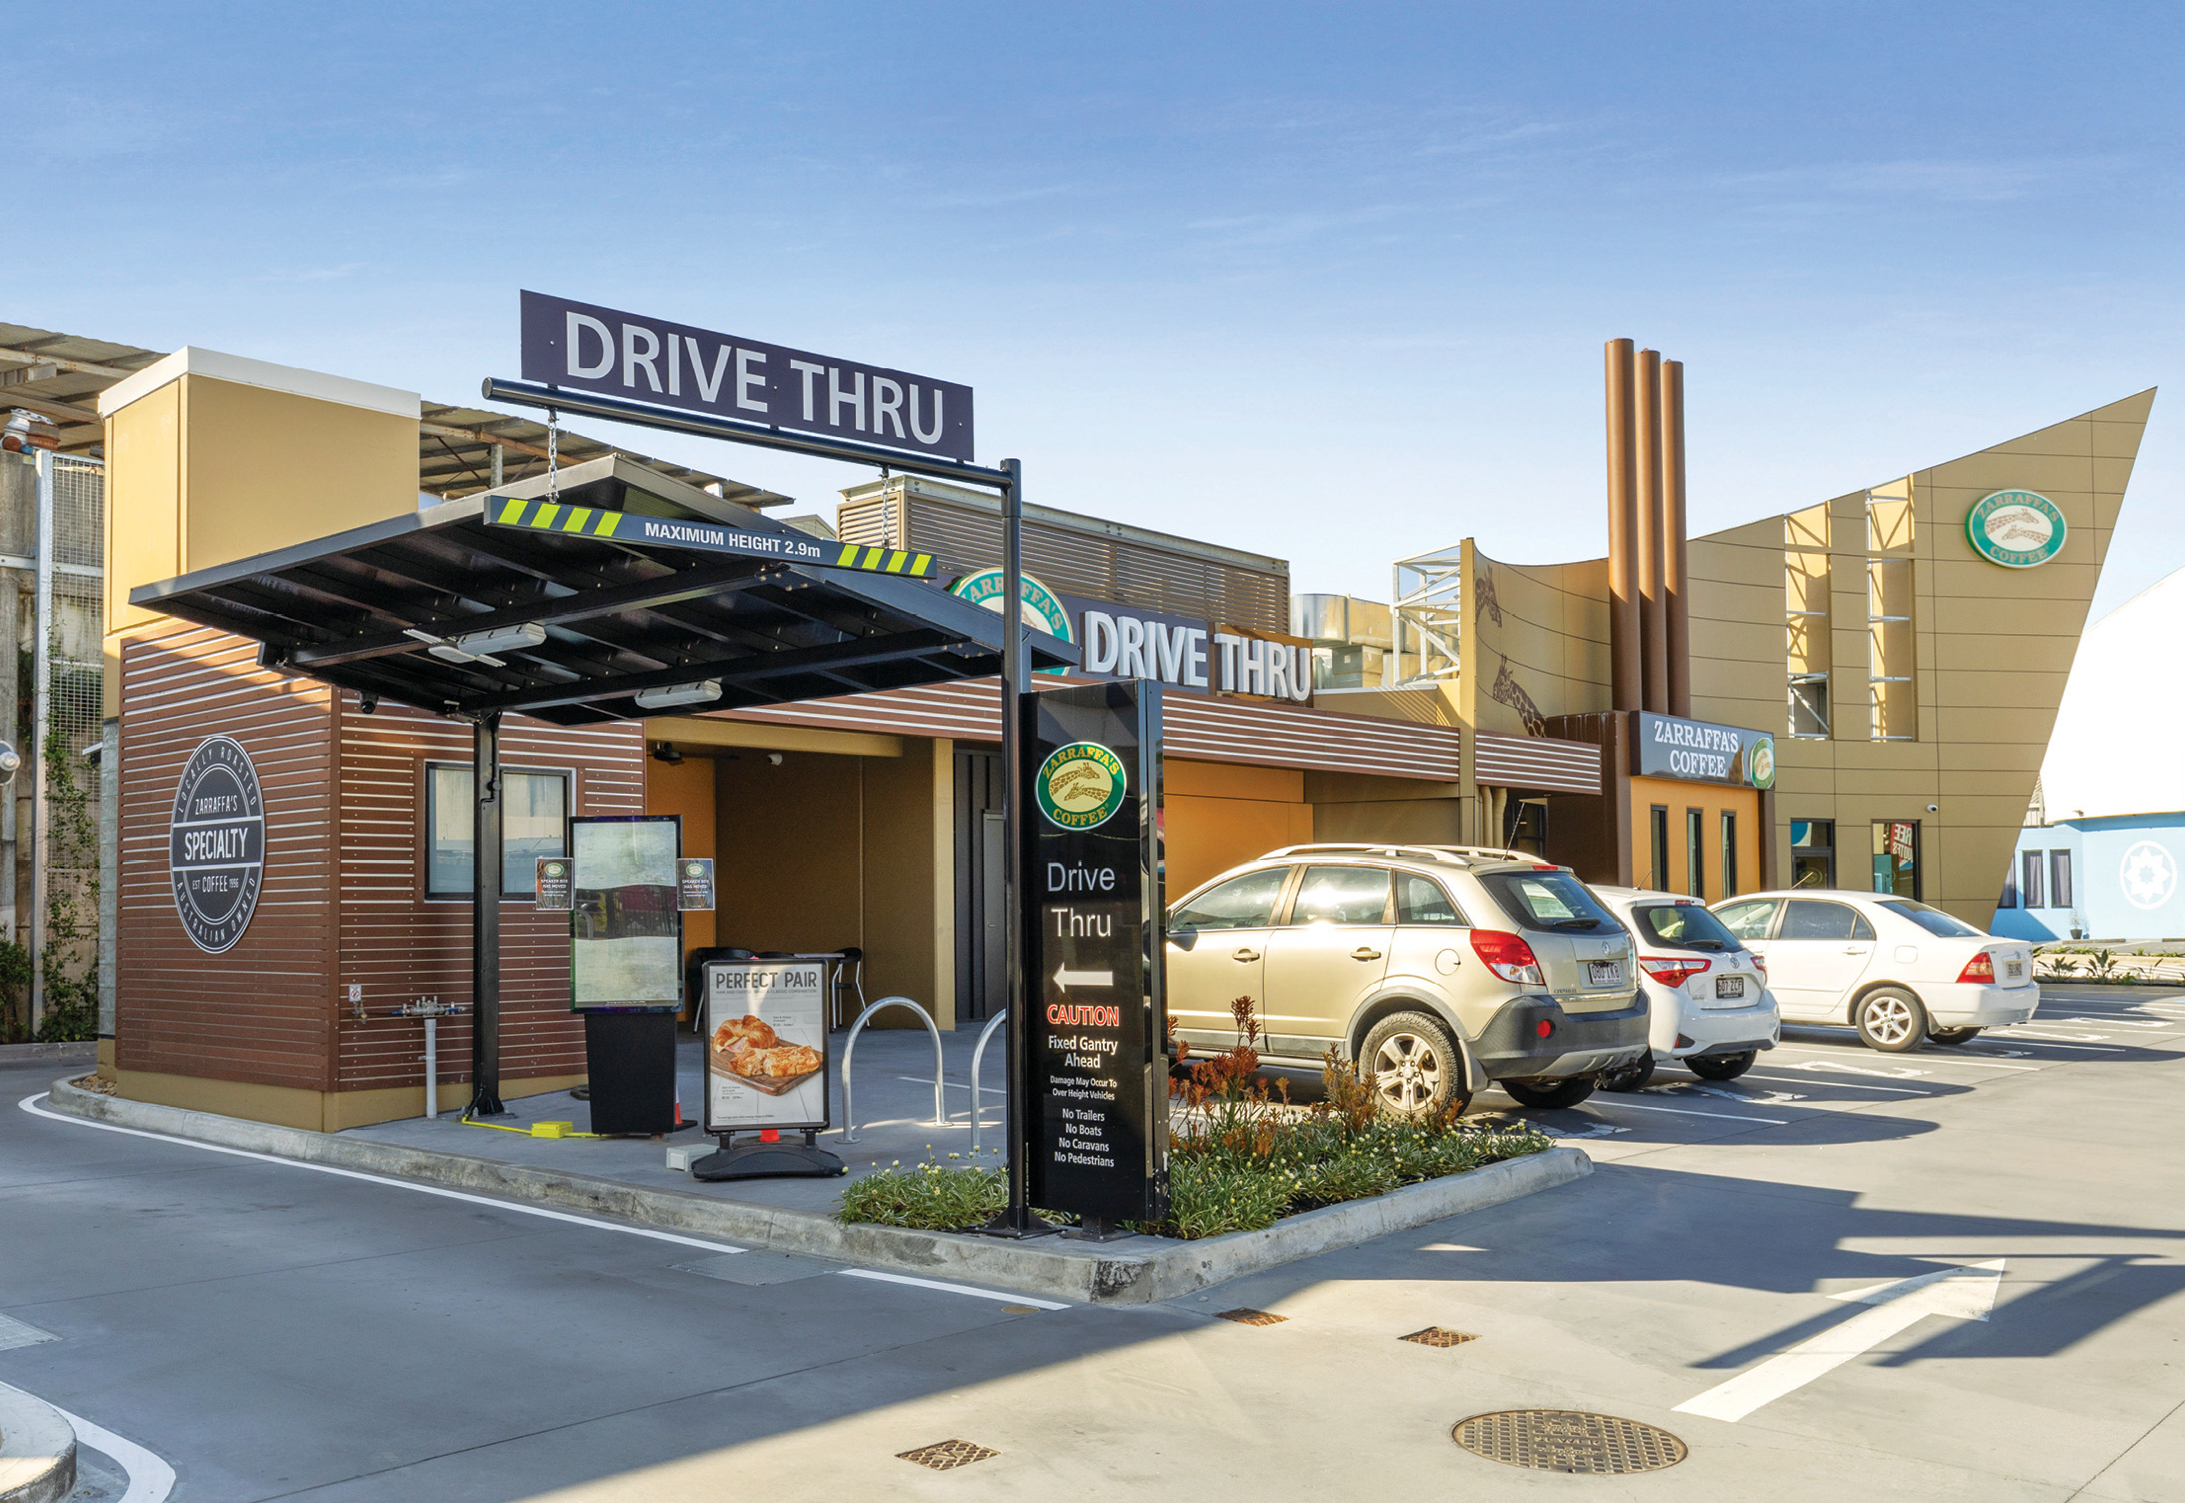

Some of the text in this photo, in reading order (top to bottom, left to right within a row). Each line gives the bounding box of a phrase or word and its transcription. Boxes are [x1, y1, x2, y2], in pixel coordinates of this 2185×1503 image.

[566, 311, 943, 444] DRIVE THRU
[1977, 493, 2060, 521] ZARRAFFA'S
[644, 522, 821, 558] MAXIMUM HEIGHT 2.9m
[1989, 546, 2048, 564] COFFEE
[1084, 610, 1311, 701] DRIVE THRU
[1654, 720, 1739, 753] ZARRAFFA'S
[1042, 746, 1120, 780] ZARRAFFA'S
[1669, 749, 1727, 777] COFFEE
[178, 746, 257, 813] LOCALLY ROASTED
[195, 795, 238, 816] ZARRAFFA'S
[1053, 806, 1108, 826] COFFEE
[184, 827, 249, 861] SPECIALTY
[192, 879, 201, 890] EST
[202, 875, 228, 893] COFFEE
[1047, 860, 1116, 892] Drive
[176, 877, 256, 942] AUSTRALIAN OWNED
[1051, 907, 1111, 937] Thru
[716, 971, 817, 989] PERFECT PAIR
[1047, 1004, 1120, 1027] CAUTION
[1048, 1034, 1118, 1056] Fixed Gantry
[1064, 1052, 1101, 1069] Ahead
[1050, 1075, 1118, 1088] Damage May Occur To
[1052, 1088, 1115, 1100] Over Height Vehicles
[1062, 1108, 1105, 1122] No Trailers
[1065, 1123, 1102, 1137] No Boats
[1059, 1137, 1110, 1152] No Caravans
[1054, 1151, 1115, 1167] No Pedestrians
